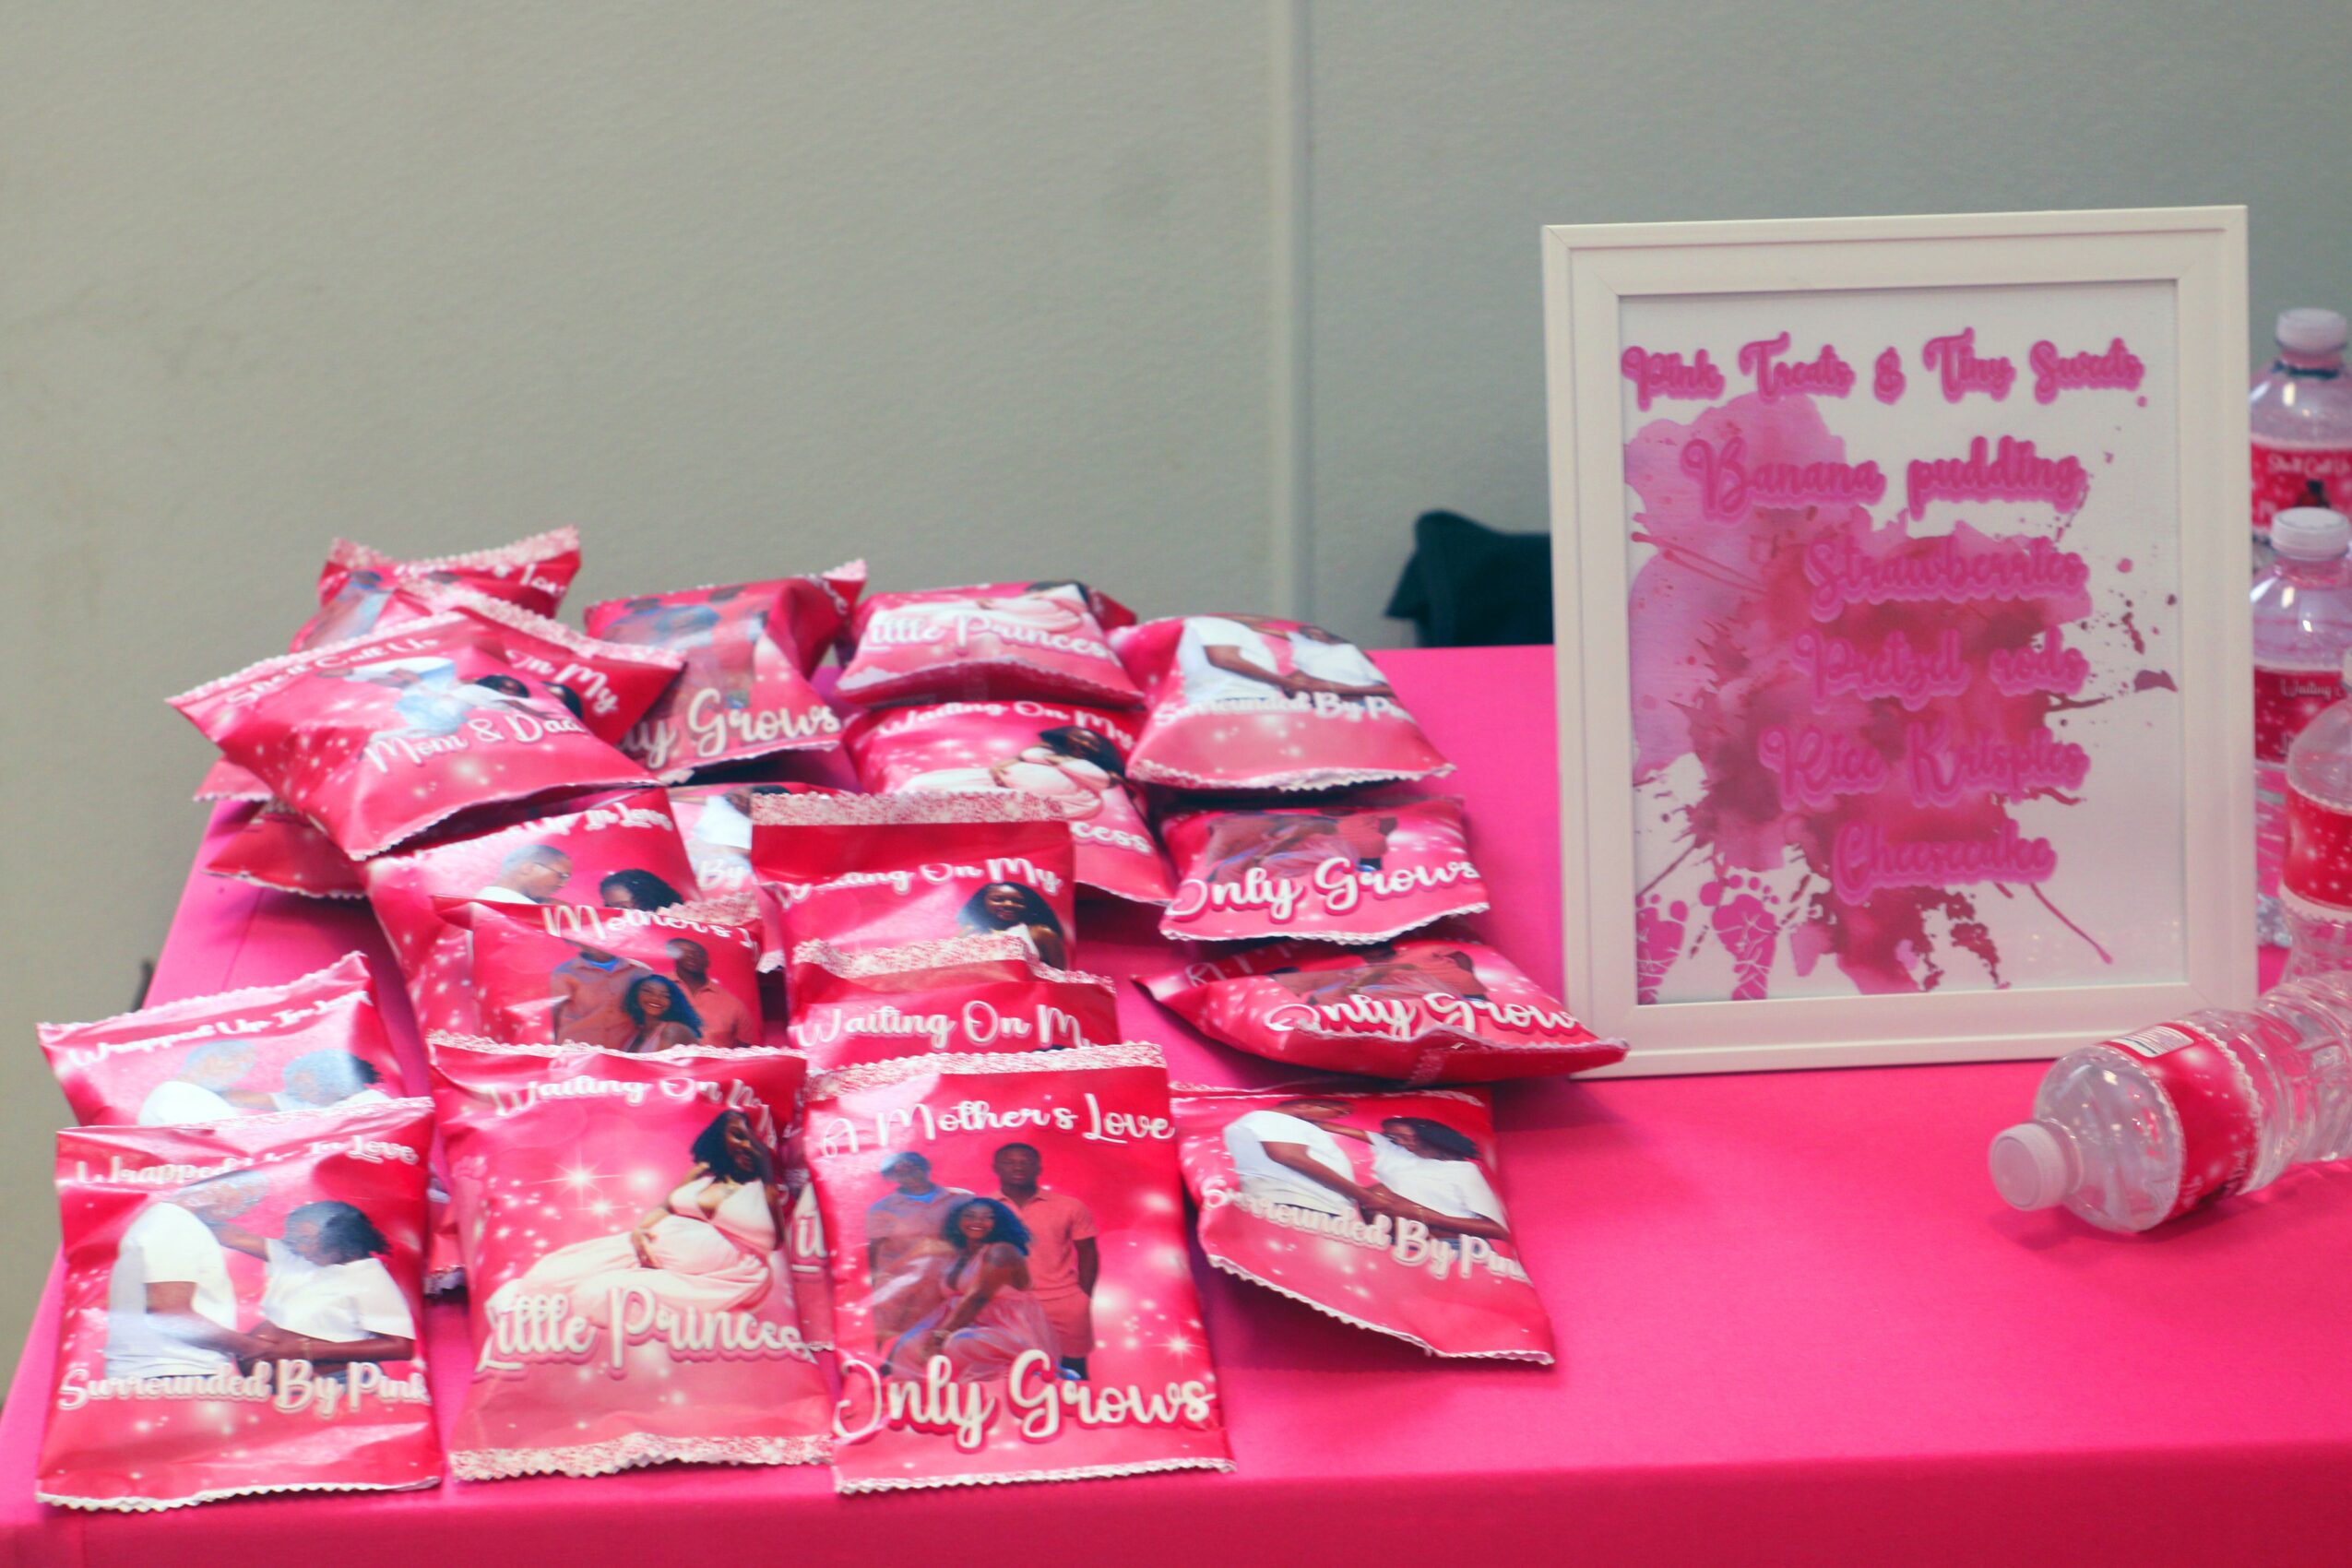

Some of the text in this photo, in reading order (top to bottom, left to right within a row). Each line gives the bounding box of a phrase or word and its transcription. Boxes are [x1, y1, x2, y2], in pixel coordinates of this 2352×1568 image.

[1621, 326, 2145, 412] Pink Treats & Tiny Sweets
[1680, 435, 2086, 526] Banana pudding
[1804, 535, 2090, 623] Strawberries
[552, 661, 620, 716] My
[1789, 624, 2089, 715] Pretzel rods
[362, 735, 469, 775] Mom
[468, 716, 506, 745] &
[686, 688, 841, 758] Grows
[877, 700, 1137, 752] Waiting On My
[1758, 725, 1888, 811] Rice
[1070, 820, 1153, 855] cess
[919, 861, 984, 884] On
[985, 857, 1063, 897] My
[1169, 856, 1479, 921] Only Grows
[797, 999, 1090, 1050] Waiting On M
[1265, 992, 1579, 1040] Only Grow
[488, 1075, 653, 1118] Waiting
[820, 1116, 861, 1158] A
[1081, 1091, 1177, 1146] Love
[77, 1152, 237, 1187] Wrapped
[347, 1134, 420, 1166] Love
[1203, 1178, 1394, 1250] Surrounded
[1393, 1216, 1456, 1279] By
[57, 1358, 432, 1420] Surrounded By Pink
[834, 1349, 1216, 1450] Only Grows
